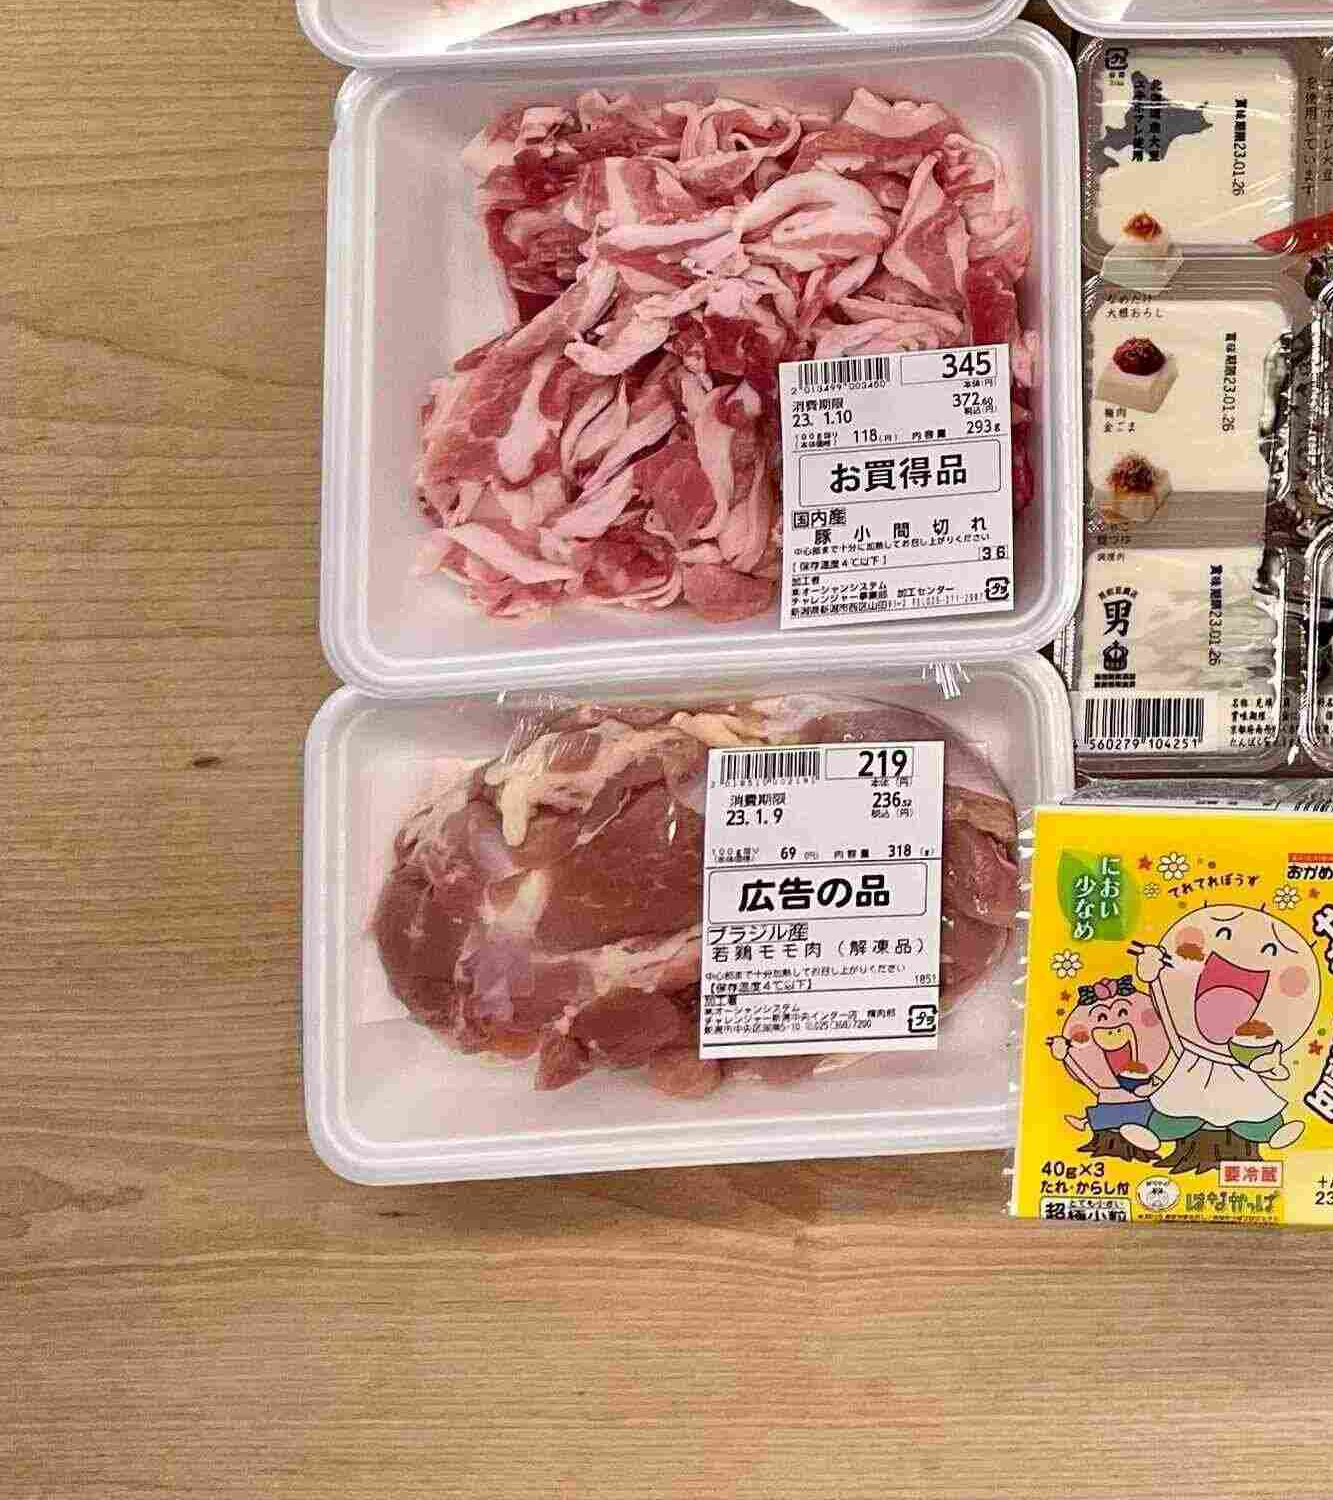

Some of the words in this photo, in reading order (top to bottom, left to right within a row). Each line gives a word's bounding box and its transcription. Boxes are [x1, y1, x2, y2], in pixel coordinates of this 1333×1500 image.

[1106, 308, 1164, 319] 大根おろし
[942, 352, 992, 378] 345
[792, 398, 844, 412] 消費期限
[793, 411, 853, 427] 23.1.10
[967, 420, 1000, 434] 293g
[830, 454, 967, 493] お買得品
[793, 508, 846, 529] 国内産
[814, 516, 987, 545] 豚小間切れ
[1103, 599, 1132, 637] 男
[1089, 737, 1139, 750] 560279
[1147, 737, 1199, 750] 104251
[858, 750, 907, 778] 219
[730, 793, 786, 806] 消費期限
[726, 809, 783, 826] 23.1.9
[780, 847, 796, 860] 69
[888, 845, 911, 858] 318
[738, 874, 890, 912] 広告の品
[1100, 857, 1120, 918] におい
[1073, 877, 1096, 940] 少なめ
[707, 924, 808, 944] ブラジル産
[1041, 1161, 1105, 1179] 40g×3
[1224, 1165, 1278, 1182] 要冷蔵
[1040, 1180, 1129, 1196] たれ・からし付
